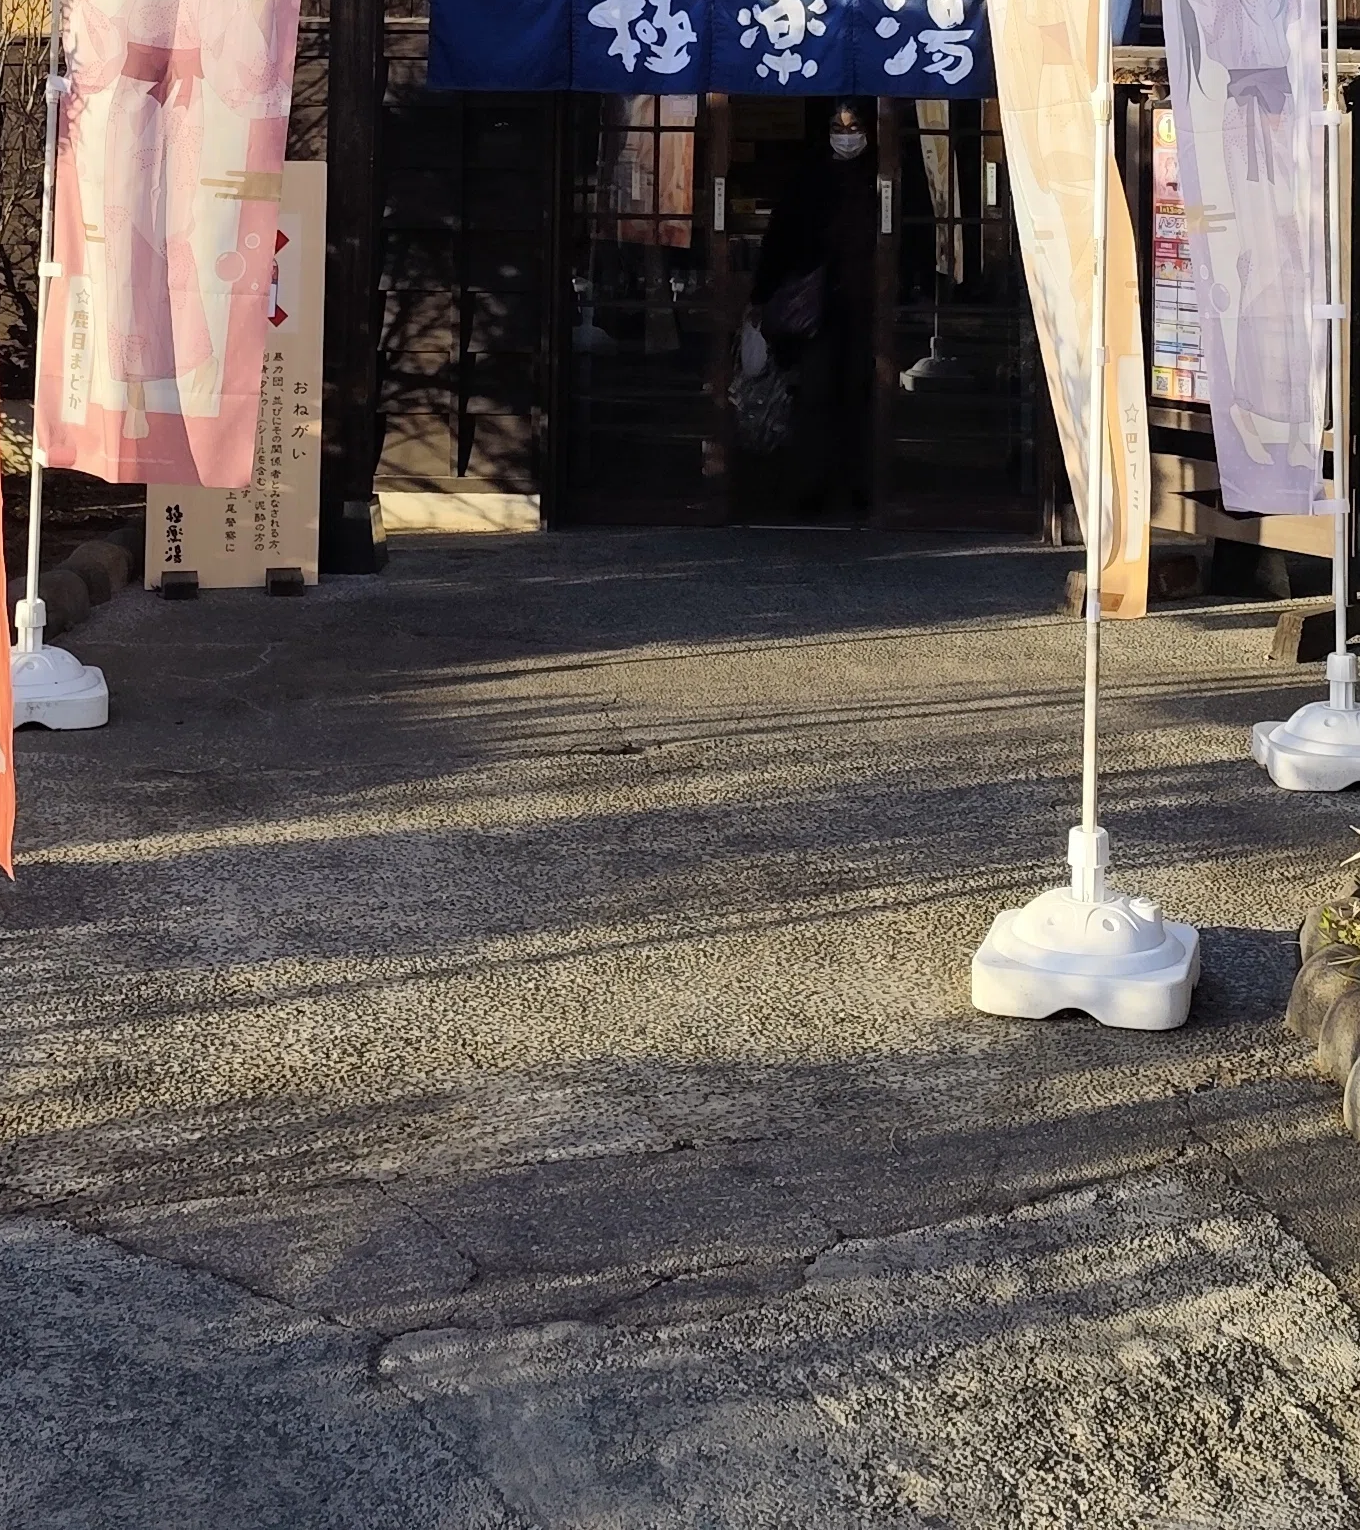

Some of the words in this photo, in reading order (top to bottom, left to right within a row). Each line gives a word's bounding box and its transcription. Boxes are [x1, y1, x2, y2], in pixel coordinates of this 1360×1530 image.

[69, 310, 89, 409] 鹿目まどか
[291, 382, 309, 459] おねがい
[165, 504, 183, 563] 極楽湯
